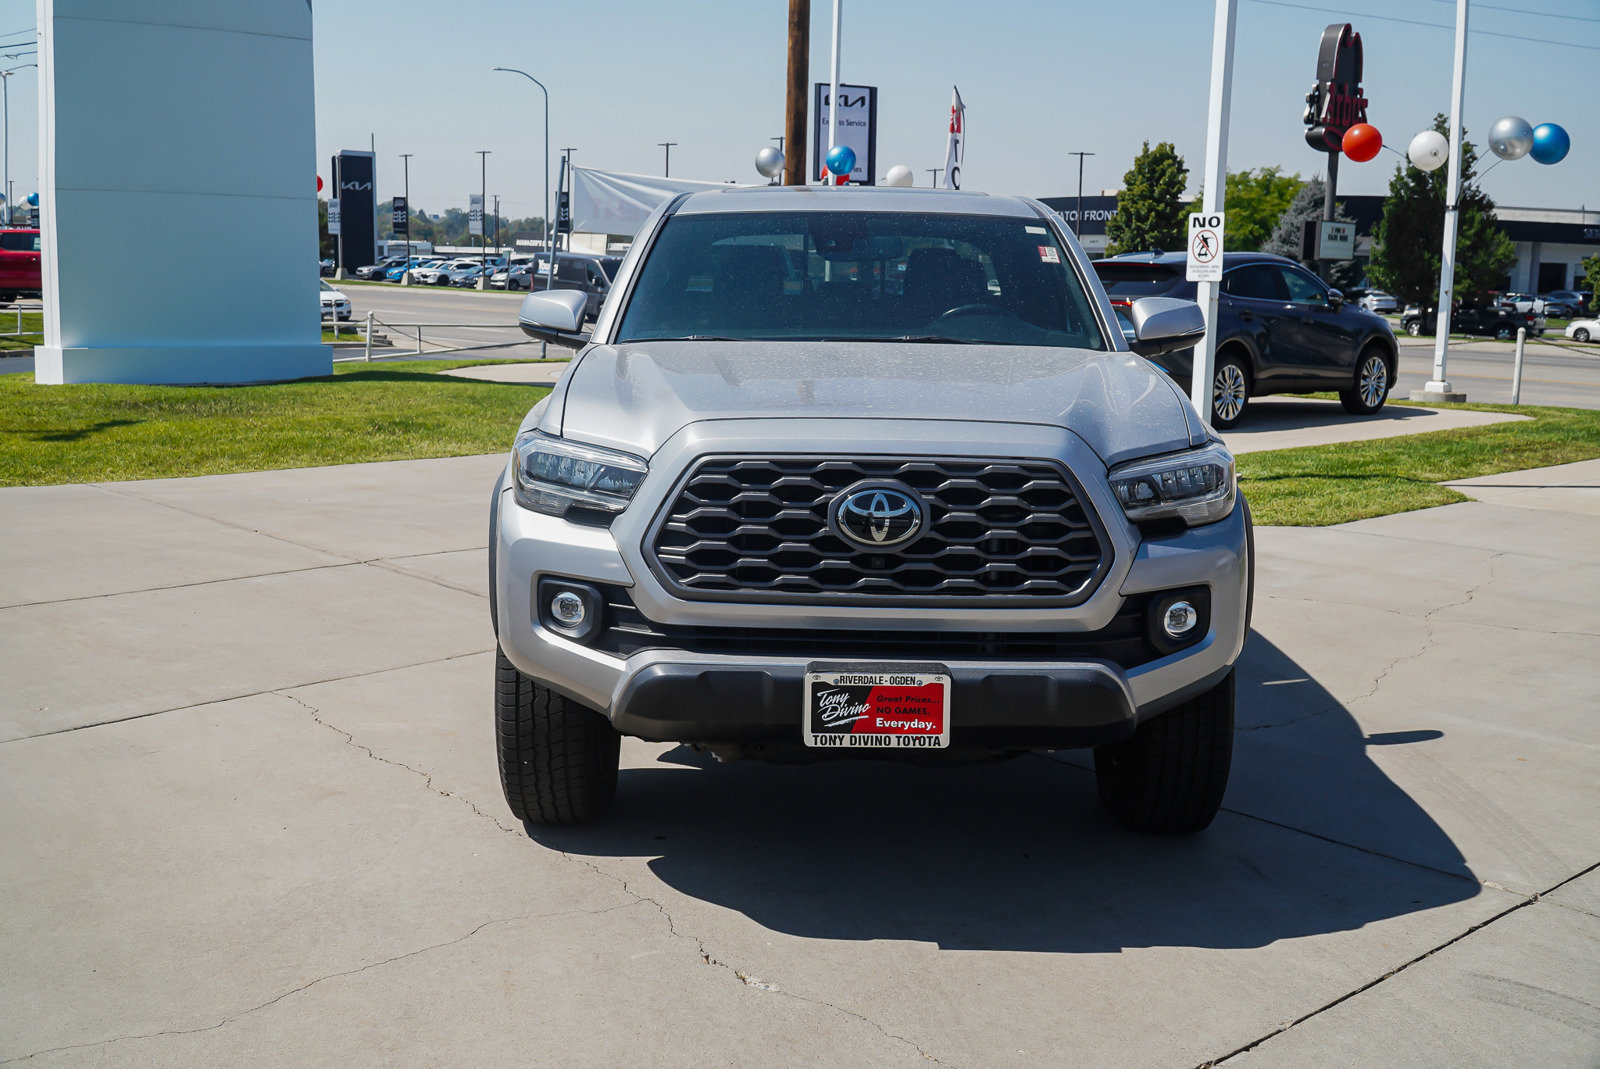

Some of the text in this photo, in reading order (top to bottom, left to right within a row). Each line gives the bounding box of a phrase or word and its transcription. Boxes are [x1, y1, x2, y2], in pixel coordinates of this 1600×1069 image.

[822, 117, 867, 127] Exss Service
[341, 181, 372, 190] KIA
[1084, 210, 1118, 221] FRONT
[1193, 216, 1221, 228] NO
[839, 675, 884, 685] RIVERDALE
[889, 676, 916, 686] OGDEN
[817, 688, 850, 708] Tony
[876, 695, 903, 703] Great
[817, 701, 871, 721] Divino
[876, 706, 930, 715] NO GAMES.
[876, 717, 936, 731] Everyday.
[813, 734, 941, 747] TONY DIVINO TOYOTA
